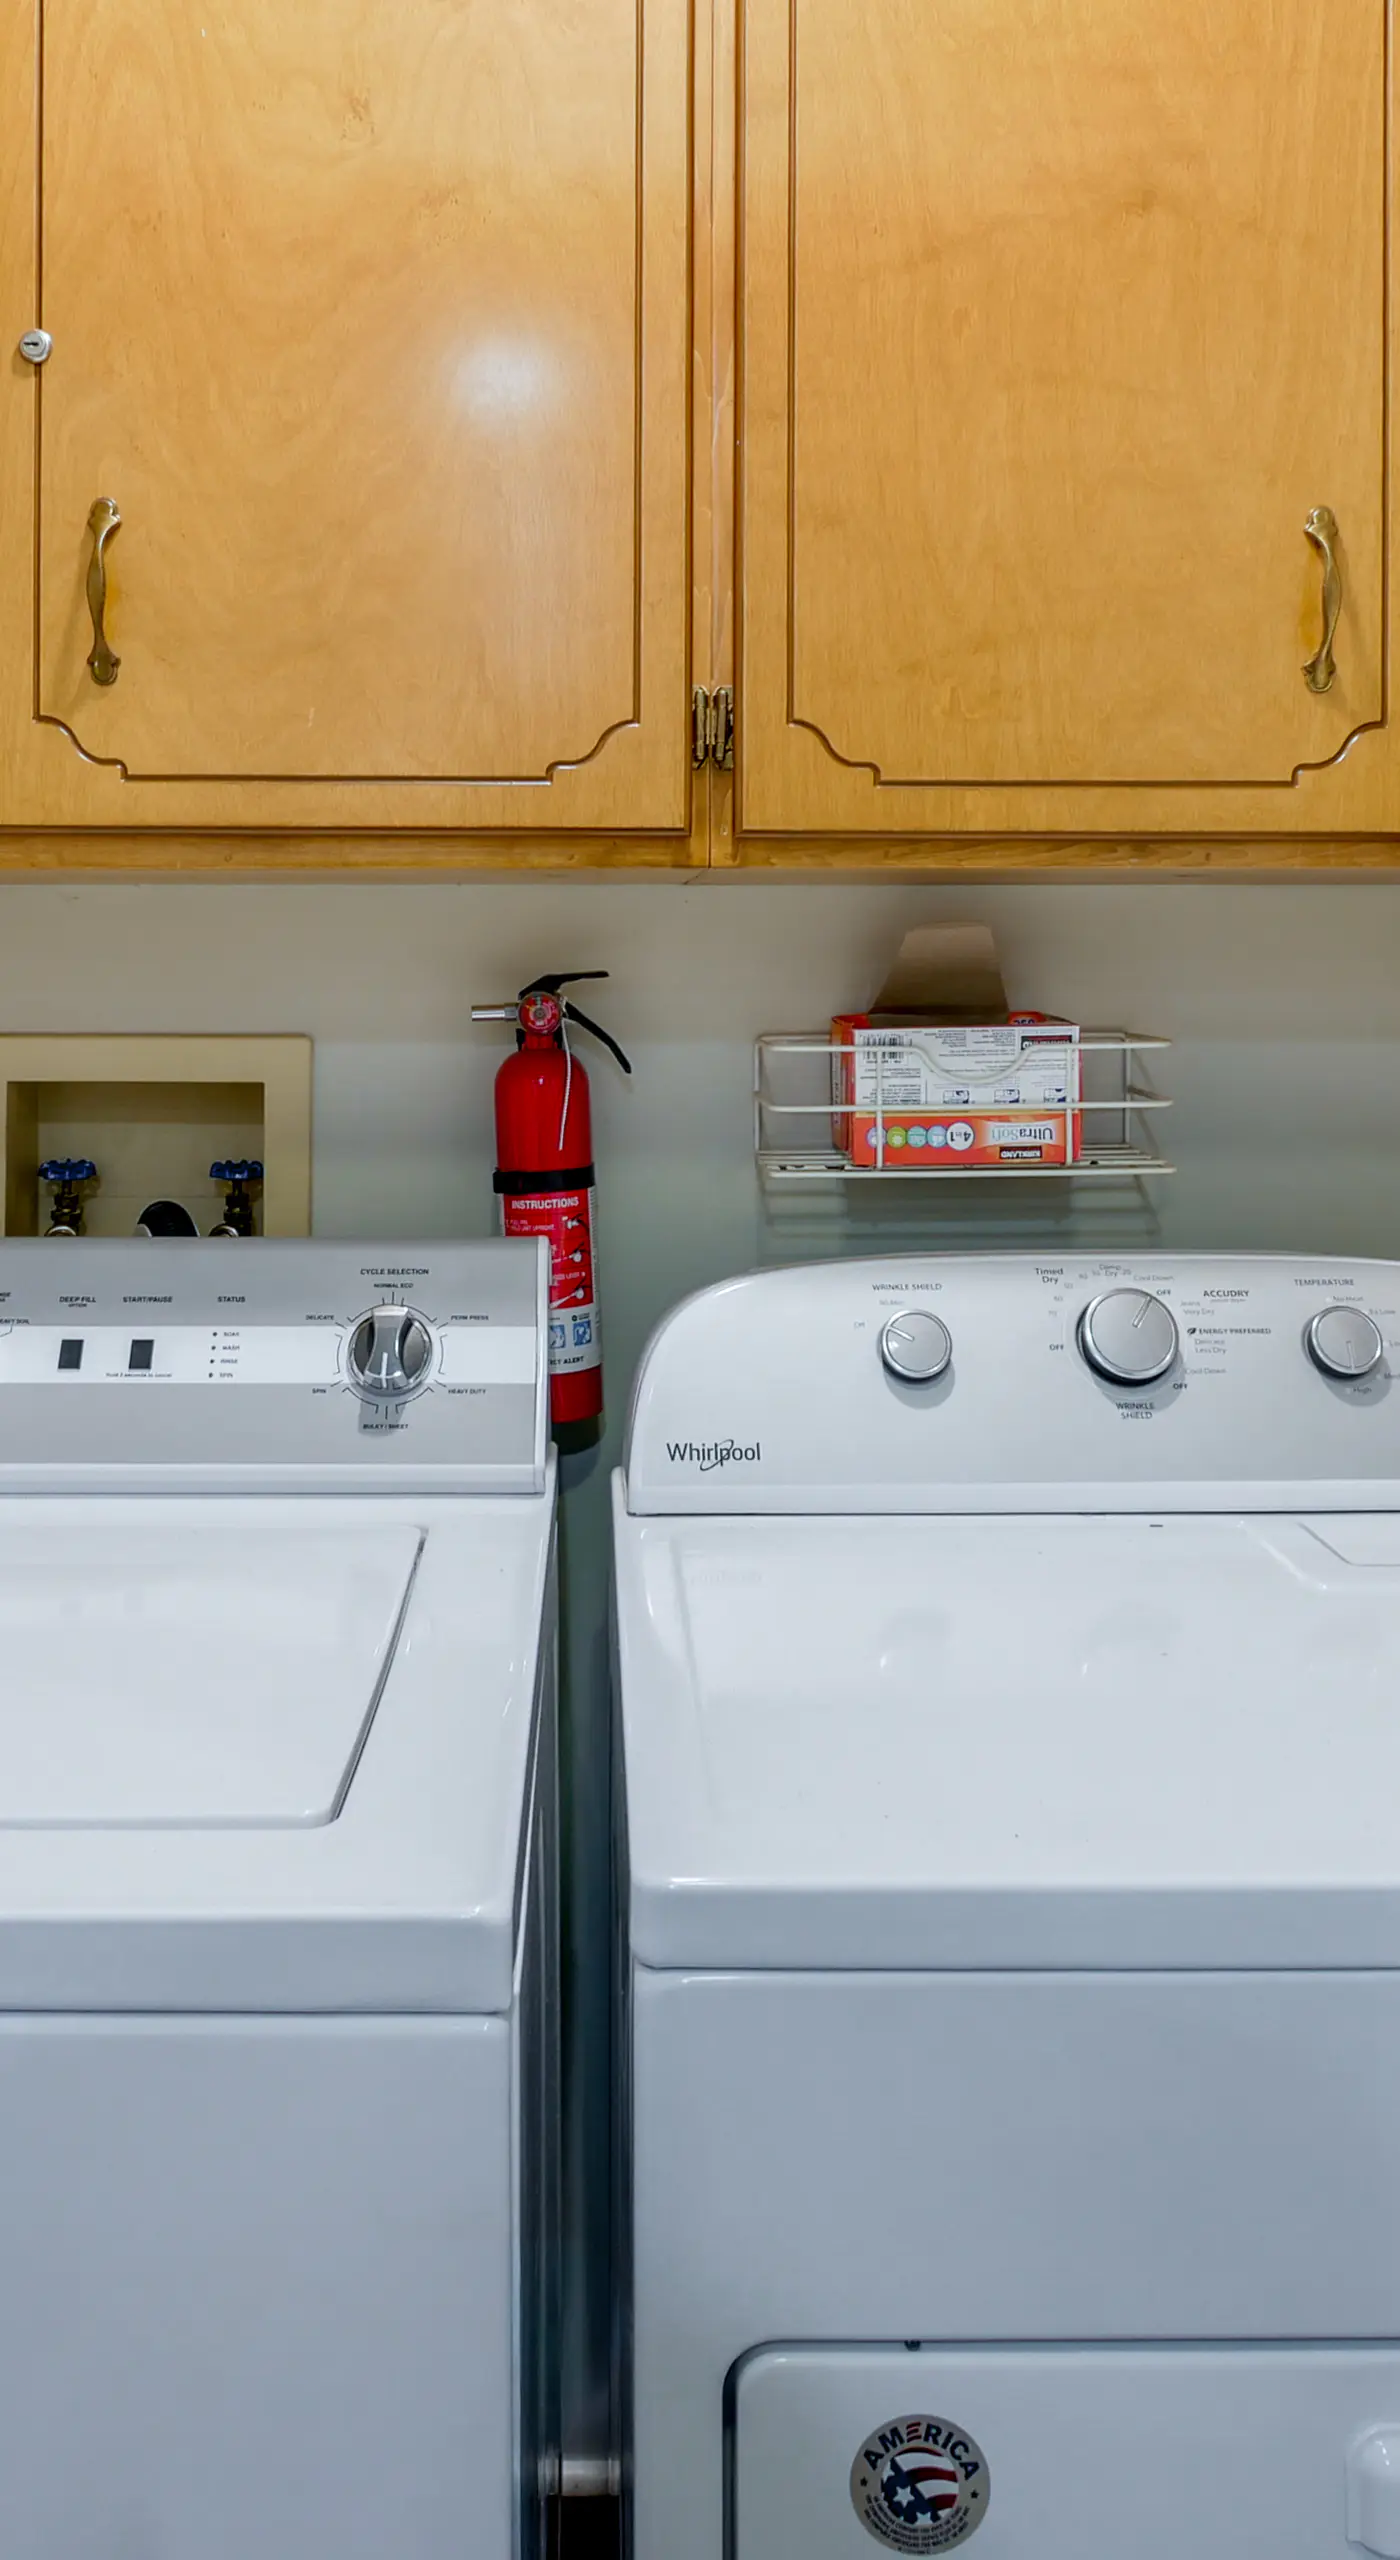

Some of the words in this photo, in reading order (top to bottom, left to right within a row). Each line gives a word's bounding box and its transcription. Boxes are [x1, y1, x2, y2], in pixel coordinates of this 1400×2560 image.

[511, 1196, 579, 1210] INSTRUCTIONS
[360, 1268, 386, 1276] CYCLE
[387, 1268, 430, 1276] SELECTION
[1035, 1267, 1064, 1275] Timed
[1042, 1276, 1059, 1284] Dry
[872, 1283, 909, 1291] WRINKLE
[911, 1283, 942, 1291] SHIELD
[1203, 1289, 1250, 1298] ACCUDRY
[1049, 1343, 1064, 1351] OFF
[1115, 1402, 1155, 1410] WRINKLE
[1121, 1411, 1153, 1419] SHIELD
[666, 1439, 761, 1471] Whirlpool
[863, 2421, 980, 2480] AMERICA
